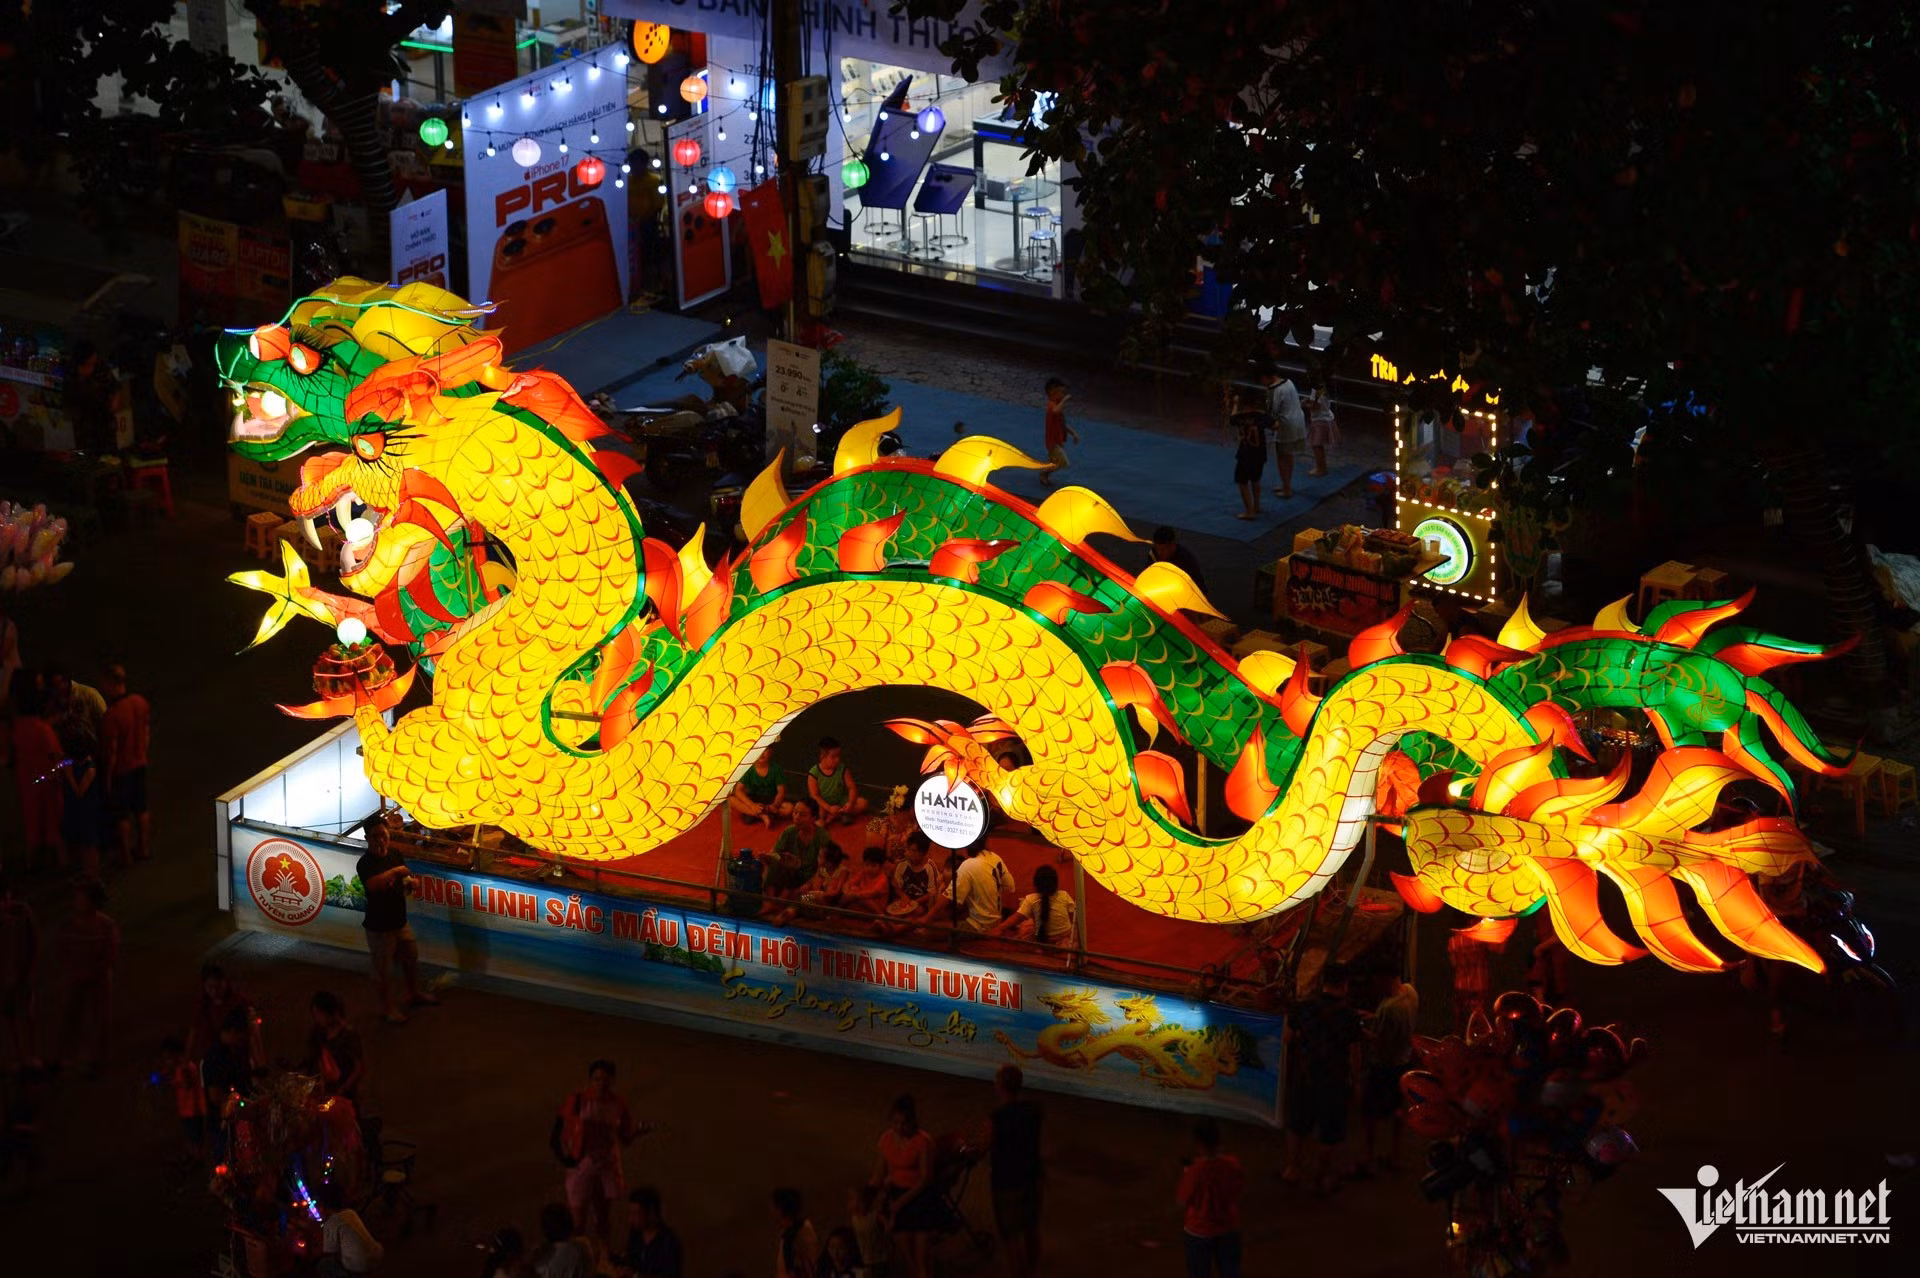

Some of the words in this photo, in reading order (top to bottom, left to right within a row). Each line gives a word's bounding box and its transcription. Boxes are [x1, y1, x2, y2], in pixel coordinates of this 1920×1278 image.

[531, 162, 560, 178] iPhone
[561, 154, 570, 167] 17
[398, 253, 445, 284] PRO
[921, 791, 979, 813] HANTA
[287, 904, 315, 920] QUANG
[413, 873, 465, 909] UNG
[471, 884, 539, 923] LINH
[686, 921, 752, 961] ĐÊM
[760, 935, 811, 976] HỘI
[819, 947, 918, 992] THÀNH
[925, 967, 1022, 1012] TUYÊN
